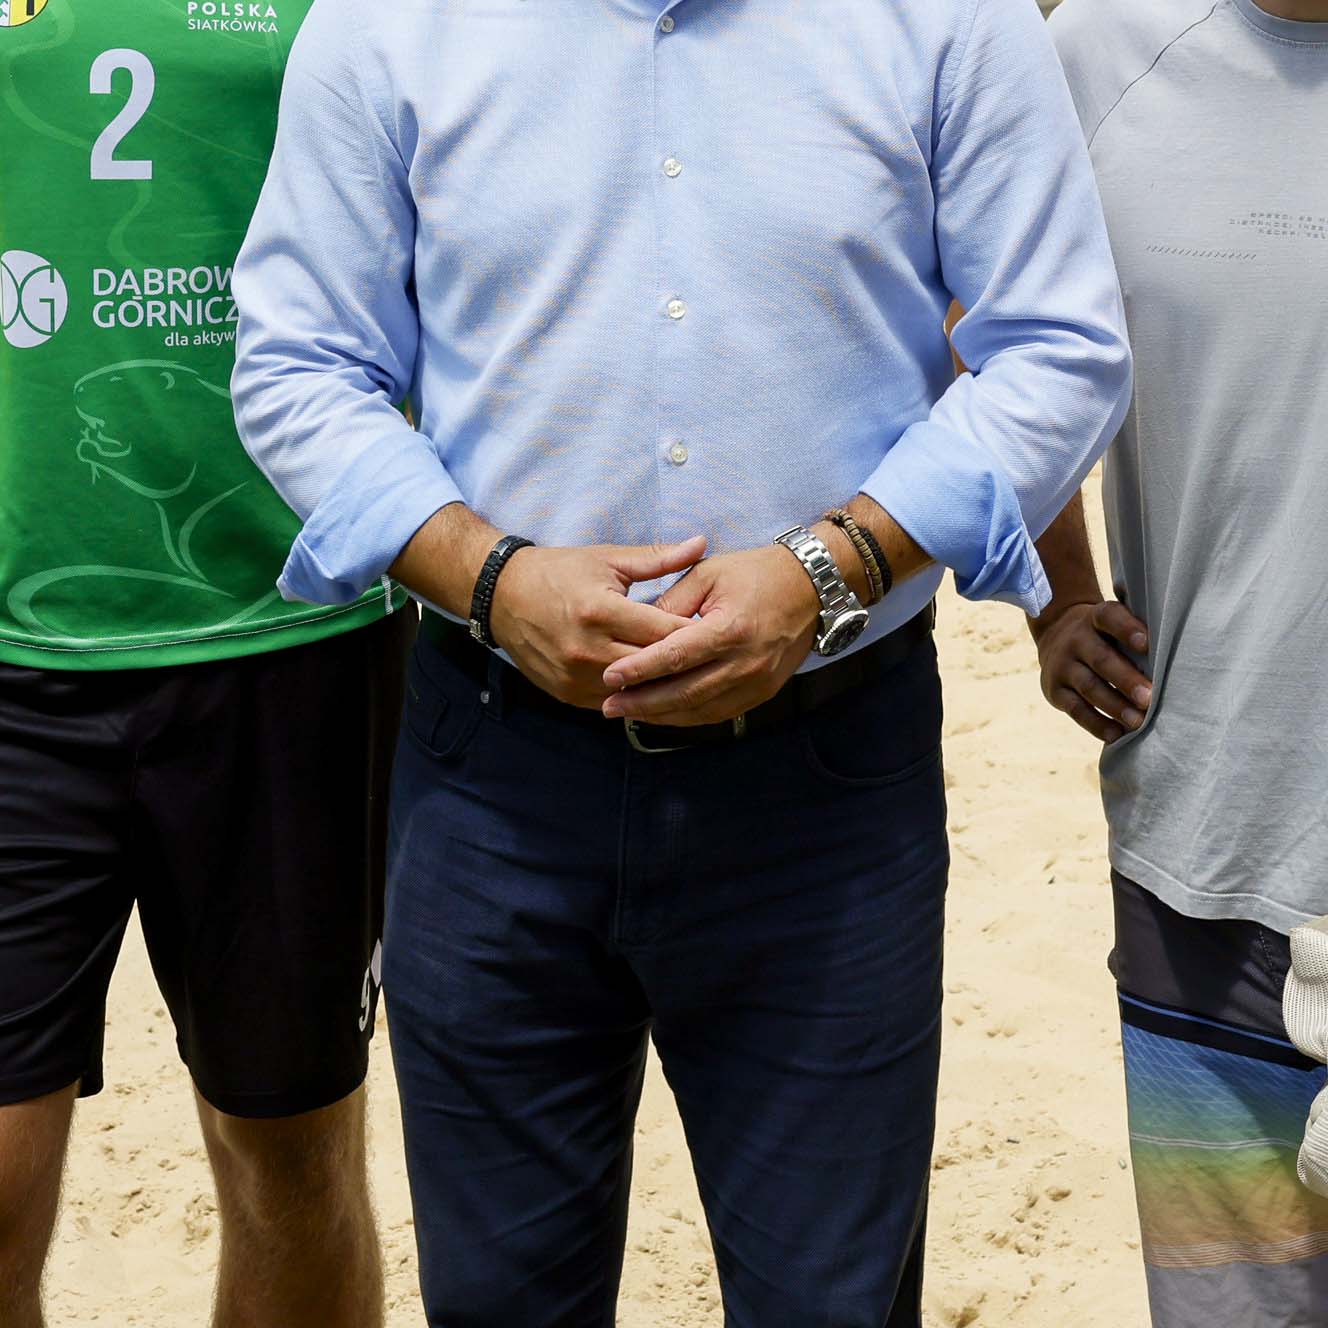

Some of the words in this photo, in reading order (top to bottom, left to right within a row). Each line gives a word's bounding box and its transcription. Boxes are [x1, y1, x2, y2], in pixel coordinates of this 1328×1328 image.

[187, 1, 278, 19] POLSKA
[187, 17, 279, 33] SIATKÓWKA
[88, 48, 156, 181] 2
[92, 296, 240, 329] GÓRNICZ
[164, 332, 189, 347] dla
